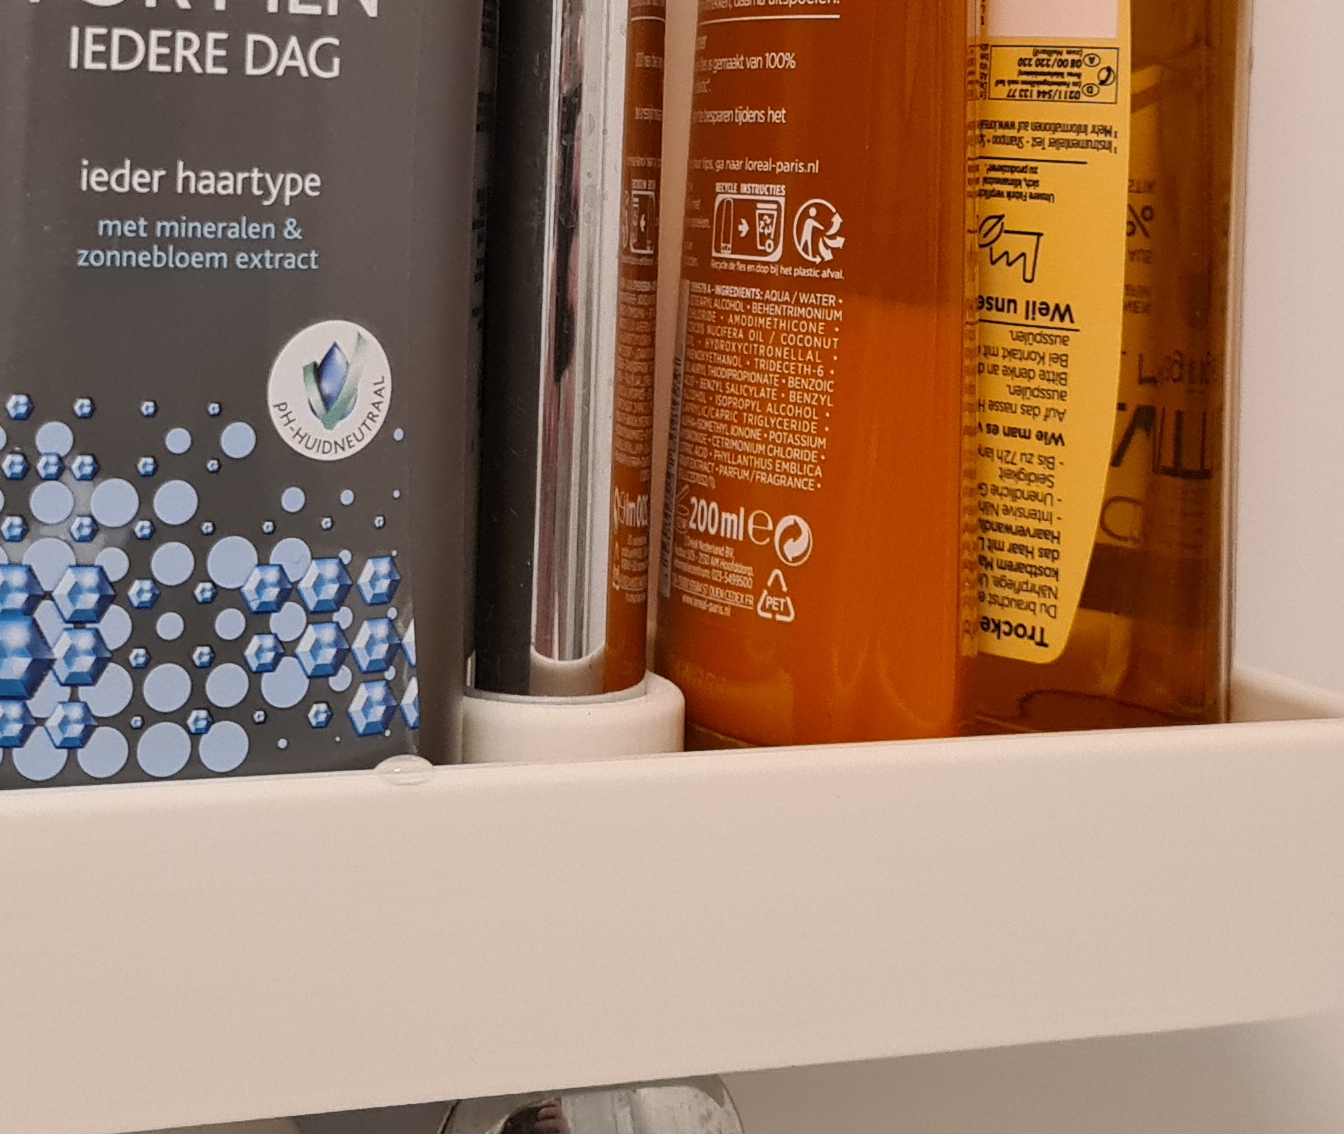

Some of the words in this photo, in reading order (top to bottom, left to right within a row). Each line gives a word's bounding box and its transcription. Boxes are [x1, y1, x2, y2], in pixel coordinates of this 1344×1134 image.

[69, 26, 229, 74] IEDERE
[244, 34, 342, 79] DAG
[746, 56, 763, 69] van
[765, 51, 797, 70] 100%
[1006, 88, 1018, 98] 77
[734, 106, 766, 126] tijdens
[767, 106, 787, 124] het
[1017, 121, 1030, 134] auf
[726, 158, 743, 170] naar
[744, 156, 820, 174] loreal-paris.nl
[80, 159, 166, 194] ieder
[175, 162, 321, 205] haartype
[740, 182, 786, 196] INSTRUCTIES
[98, 217, 148, 239] met
[156, 216, 277, 240] mineralen
[283, 219, 302, 241] &
[77, 244, 228, 269] zonnebloem
[235, 248, 319, 270] extract
[780, 265, 793, 277] het
[794, 266, 820, 279] plastic
[821, 268, 845, 281] afval.
[764, 290, 791, 304] AQUA
[799, 292, 836, 307] WATER
[713, 298, 745, 313] ALCOHOL
[752, 303, 843, 322] BEHENTRIMONIUM
[1025, 300, 1075, 324] Weil
[727, 314, 826, 334] AMODIMETHICONE
[748, 329, 764, 343] OIL
[780, 332, 840, 350] COCONUT
[1002, 347, 1046, 366] Kontakt
[1049, 353, 1069, 368] Bei
[754, 357, 825, 377] TRIDECETH-6
[986, 364, 1000, 376] an
[1002, 365, 1036, 382] denke
[787, 377, 835, 394] BENZOIC
[1038, 369, 1068, 387] Bitte
[725, 382, 778, 401] SALICYLATE
[789, 391, 834, 407] BENZYL
[715, 394, 762, 413] ISOPROPYL
[766, 401, 820, 420] ALCOHOL
[988, 400, 1017, 415] nasse
[1020, 404, 1041, 421] das
[1043, 407, 1067, 422] Auf
[743, 412, 818, 434] TRIGLYCERIDE
[986, 423, 1000, 436] es
[730, 424, 762, 441] IONONE
[768, 430, 827, 450] POTASSIUM
[1002, 426, 1032, 441] man
[1036, 430, 1065, 447] Wie
[712, 436, 766, 456] CETRIMONIUM
[767, 444, 818, 463] CHLORIDE
[713, 450, 773, 471] PHYLLANTHUS
[775, 460, 823, 478] EMBLICA
[1020, 452, 1034, 467] zu
[990, 483, 1054, 506] Unendliche
[1001, 505, 1053, 525] Intensive
[1008, 543, 1035, 561] Haar
[1038, 546, 1061, 563] das
[996, 559, 1060, 582] kostbarem
[765, 596, 786, 612] PET
[1040, 603, 1058, 619] Du
